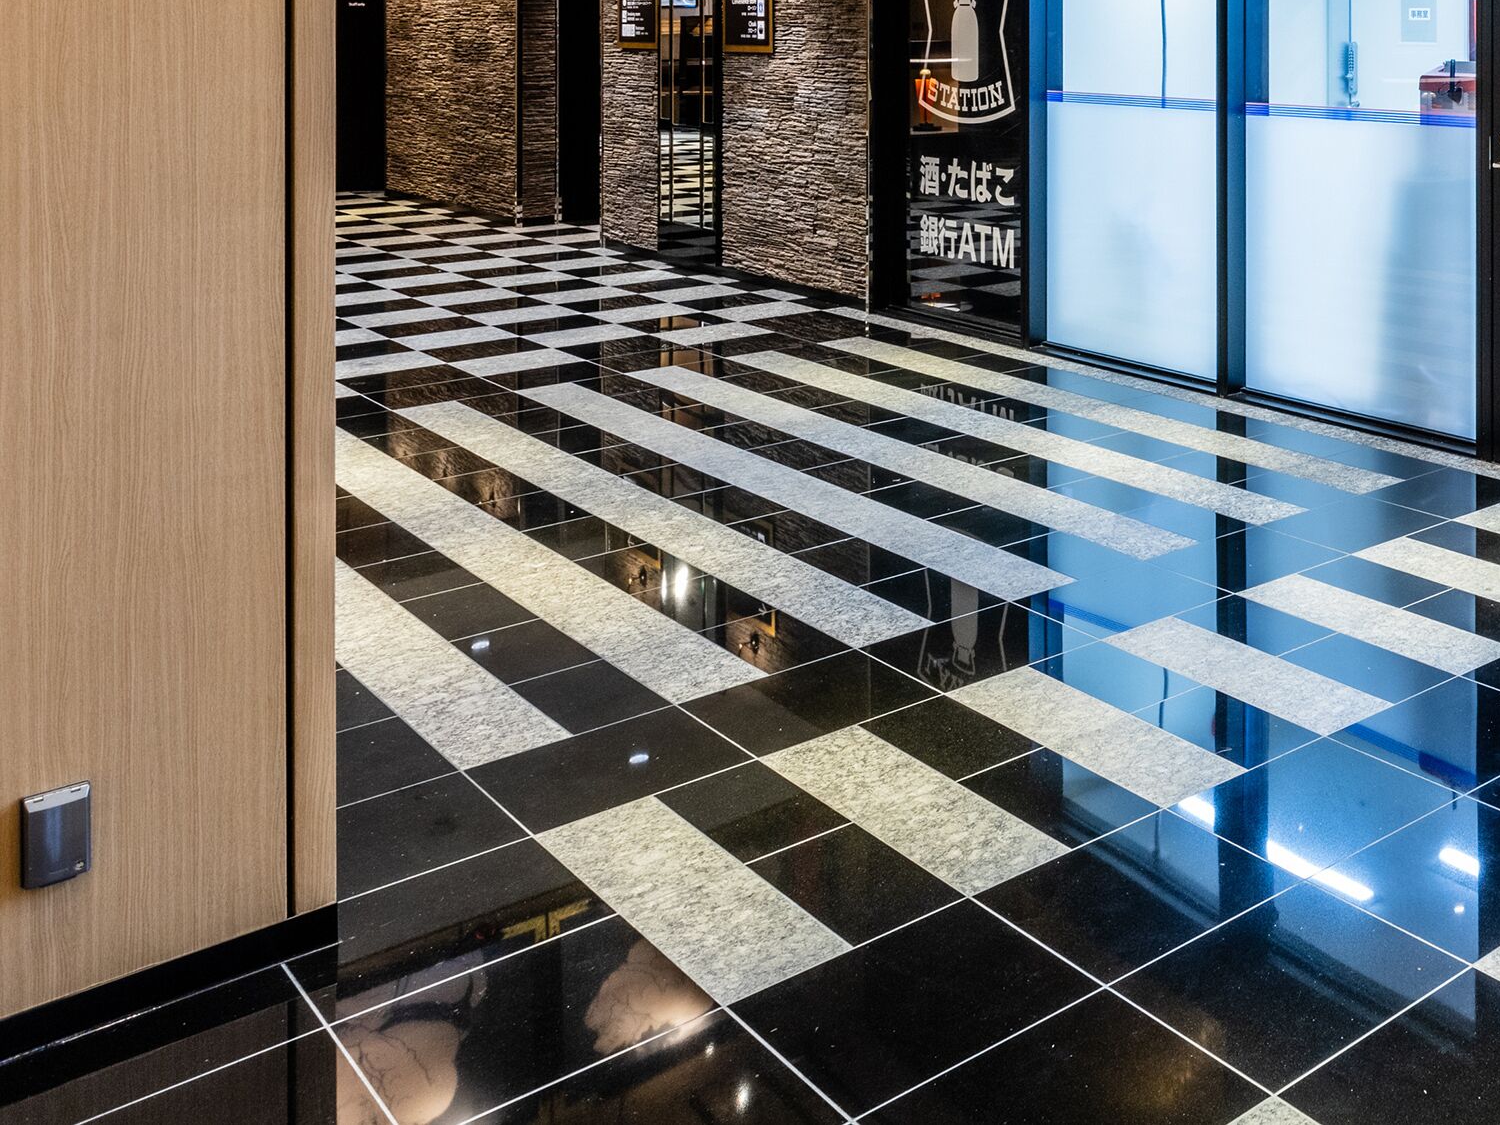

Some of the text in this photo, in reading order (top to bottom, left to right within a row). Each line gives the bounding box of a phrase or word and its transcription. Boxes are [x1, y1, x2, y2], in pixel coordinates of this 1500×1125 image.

[927, 78, 1005, 112] STATION
[920, 155, 1015, 206] 酒・たばこ
[920, 214, 1015, 269] 銀行ATM
